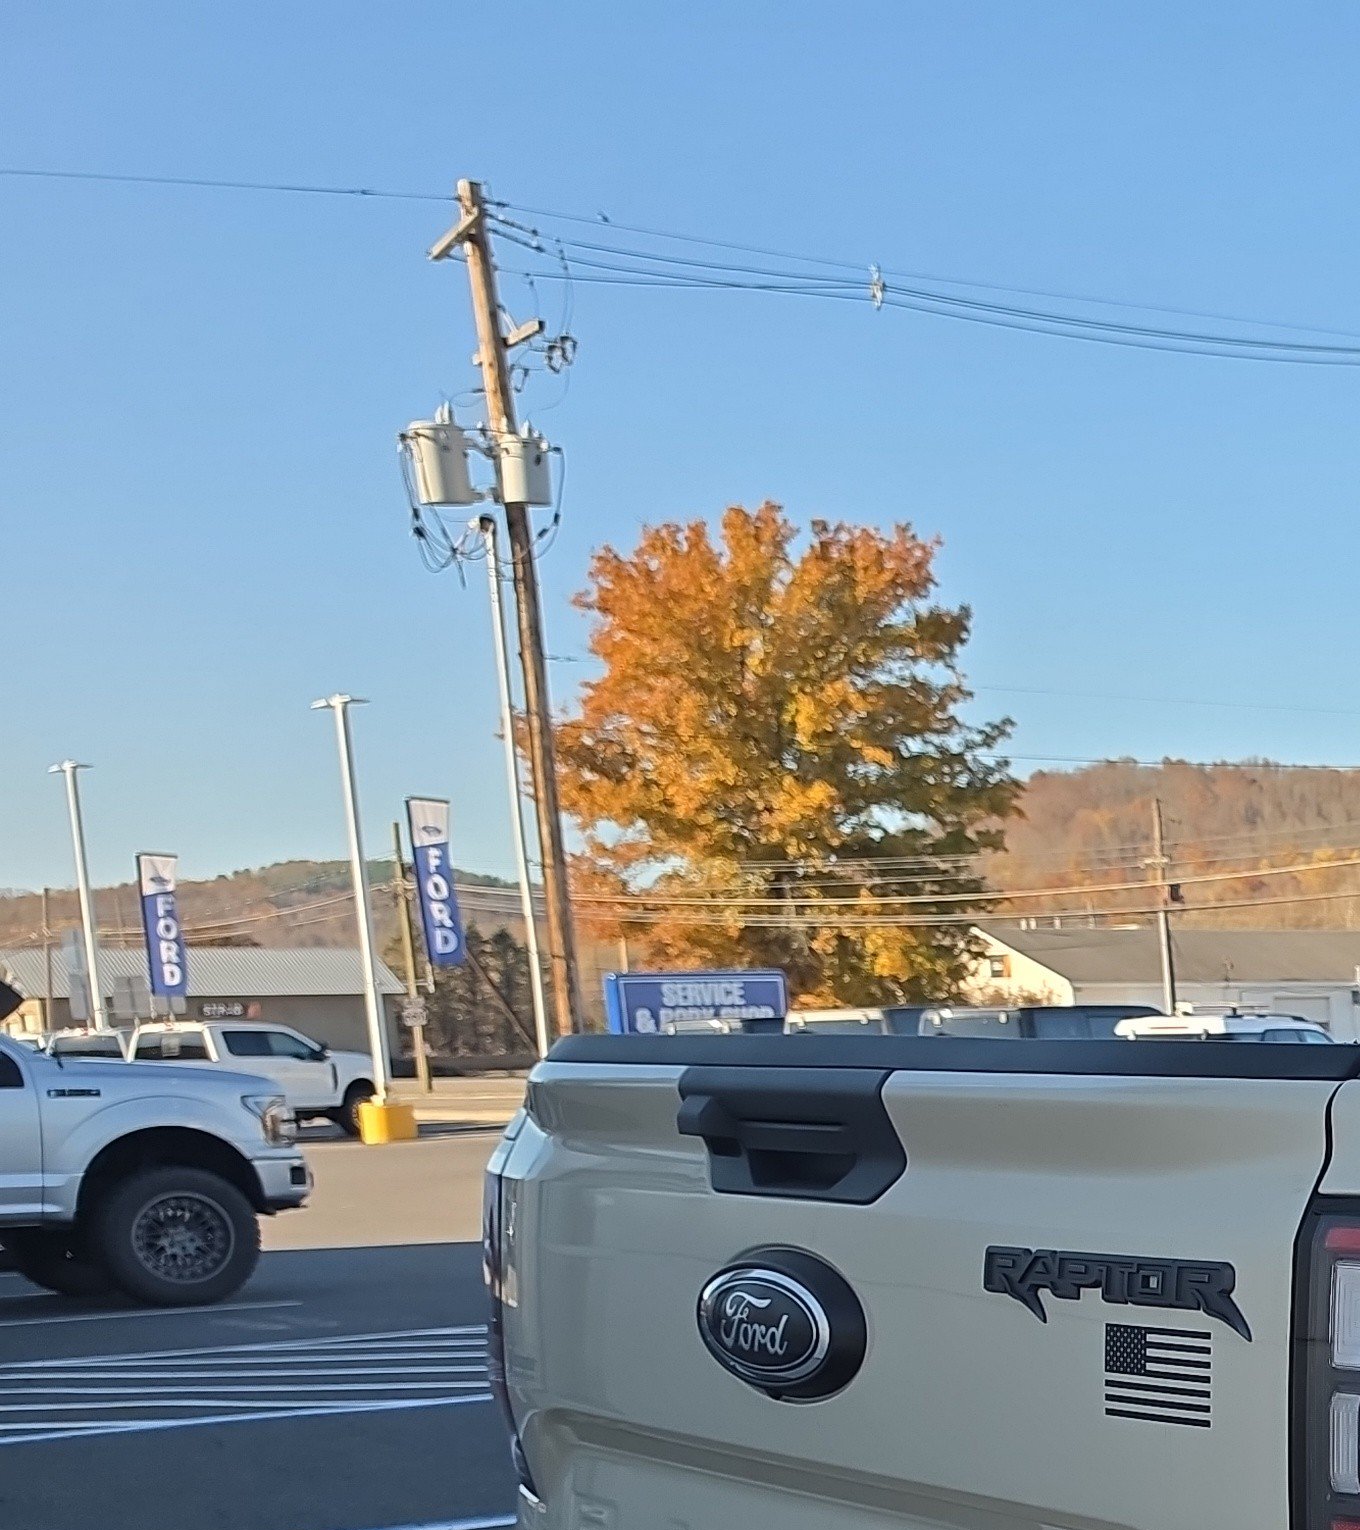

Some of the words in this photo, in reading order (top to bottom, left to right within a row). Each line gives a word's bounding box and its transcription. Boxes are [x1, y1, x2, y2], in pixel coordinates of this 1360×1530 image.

[426, 846, 459, 955] FORD
[155, 896, 183, 987] FORD
[635, 1007, 658, 1034] &
[661, 982, 747, 1007] SERVICE
[722, 1290, 789, 1356] Ford
[983, 1245, 1253, 1343] RAPTOR
